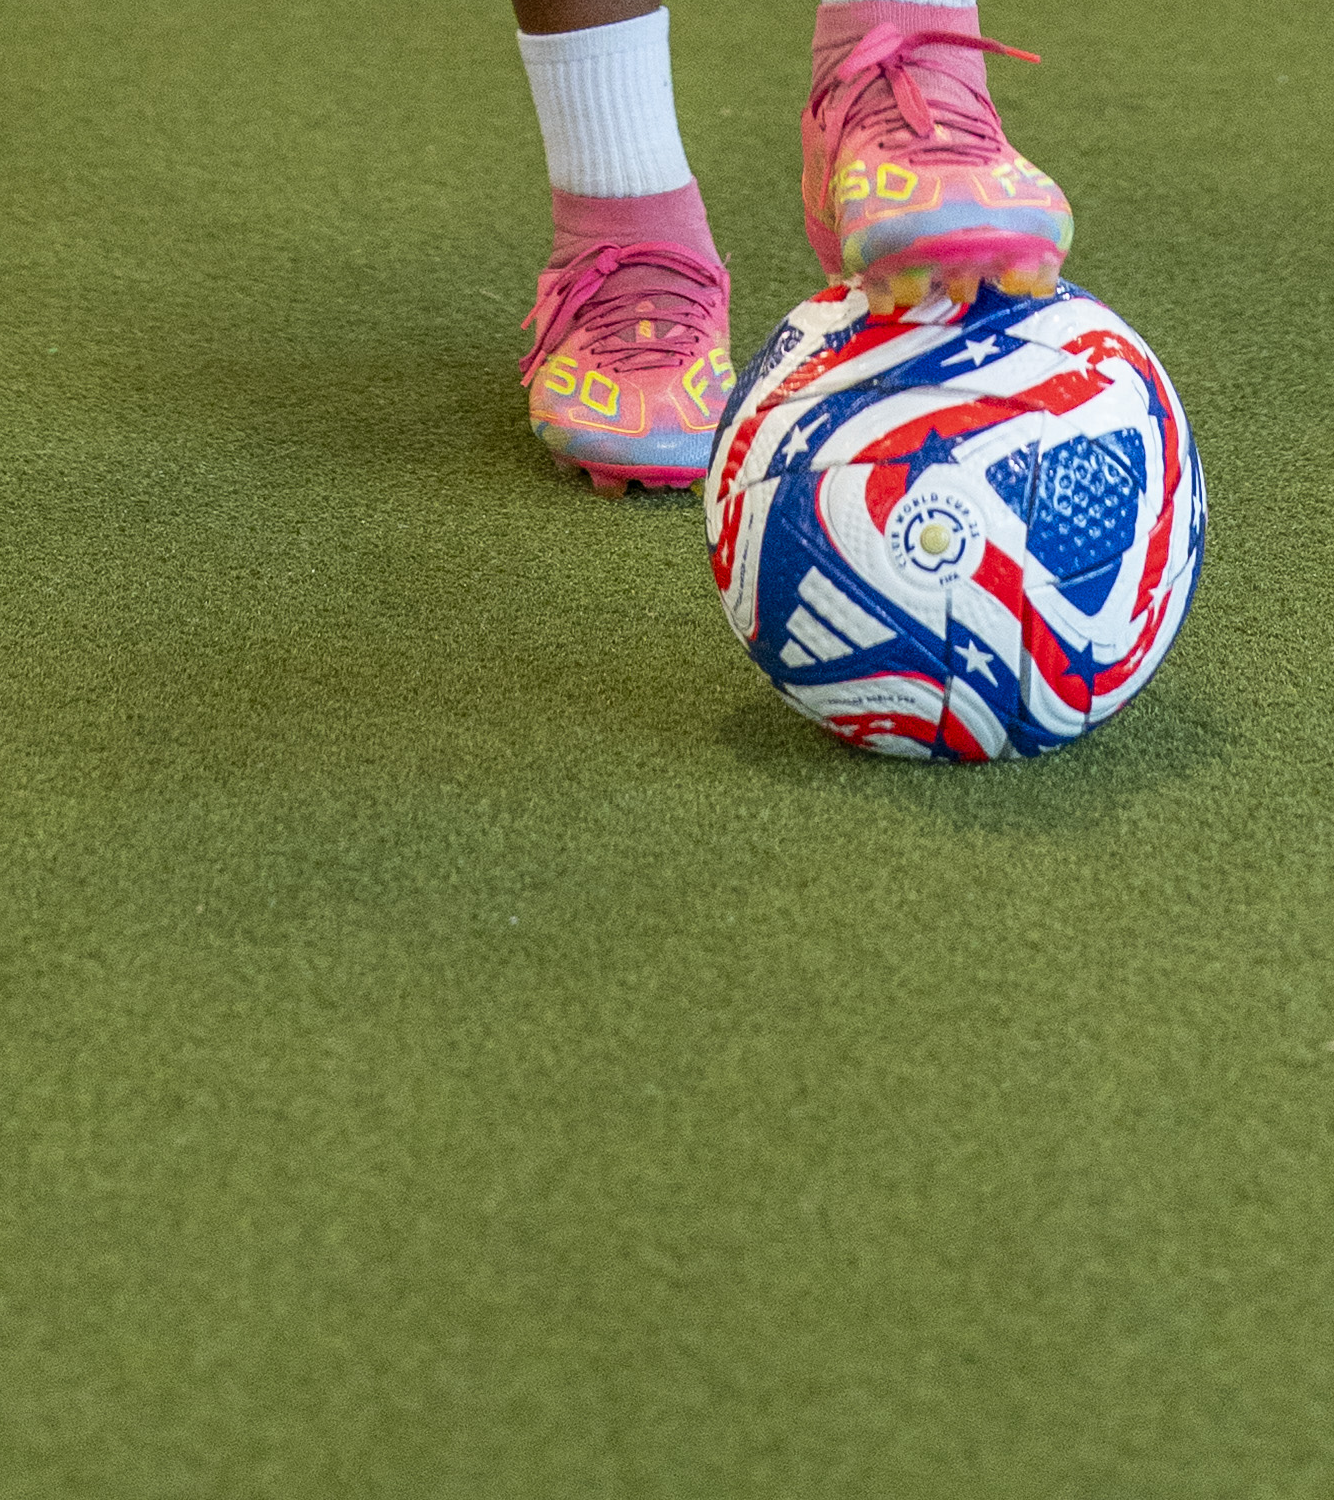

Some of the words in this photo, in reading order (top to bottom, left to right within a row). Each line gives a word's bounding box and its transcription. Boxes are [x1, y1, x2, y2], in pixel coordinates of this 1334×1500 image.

[895, 492, 939, 524] WORLD
[945, 495, 971, 516] CUP
[938, 572, 960, 586] FIFA
